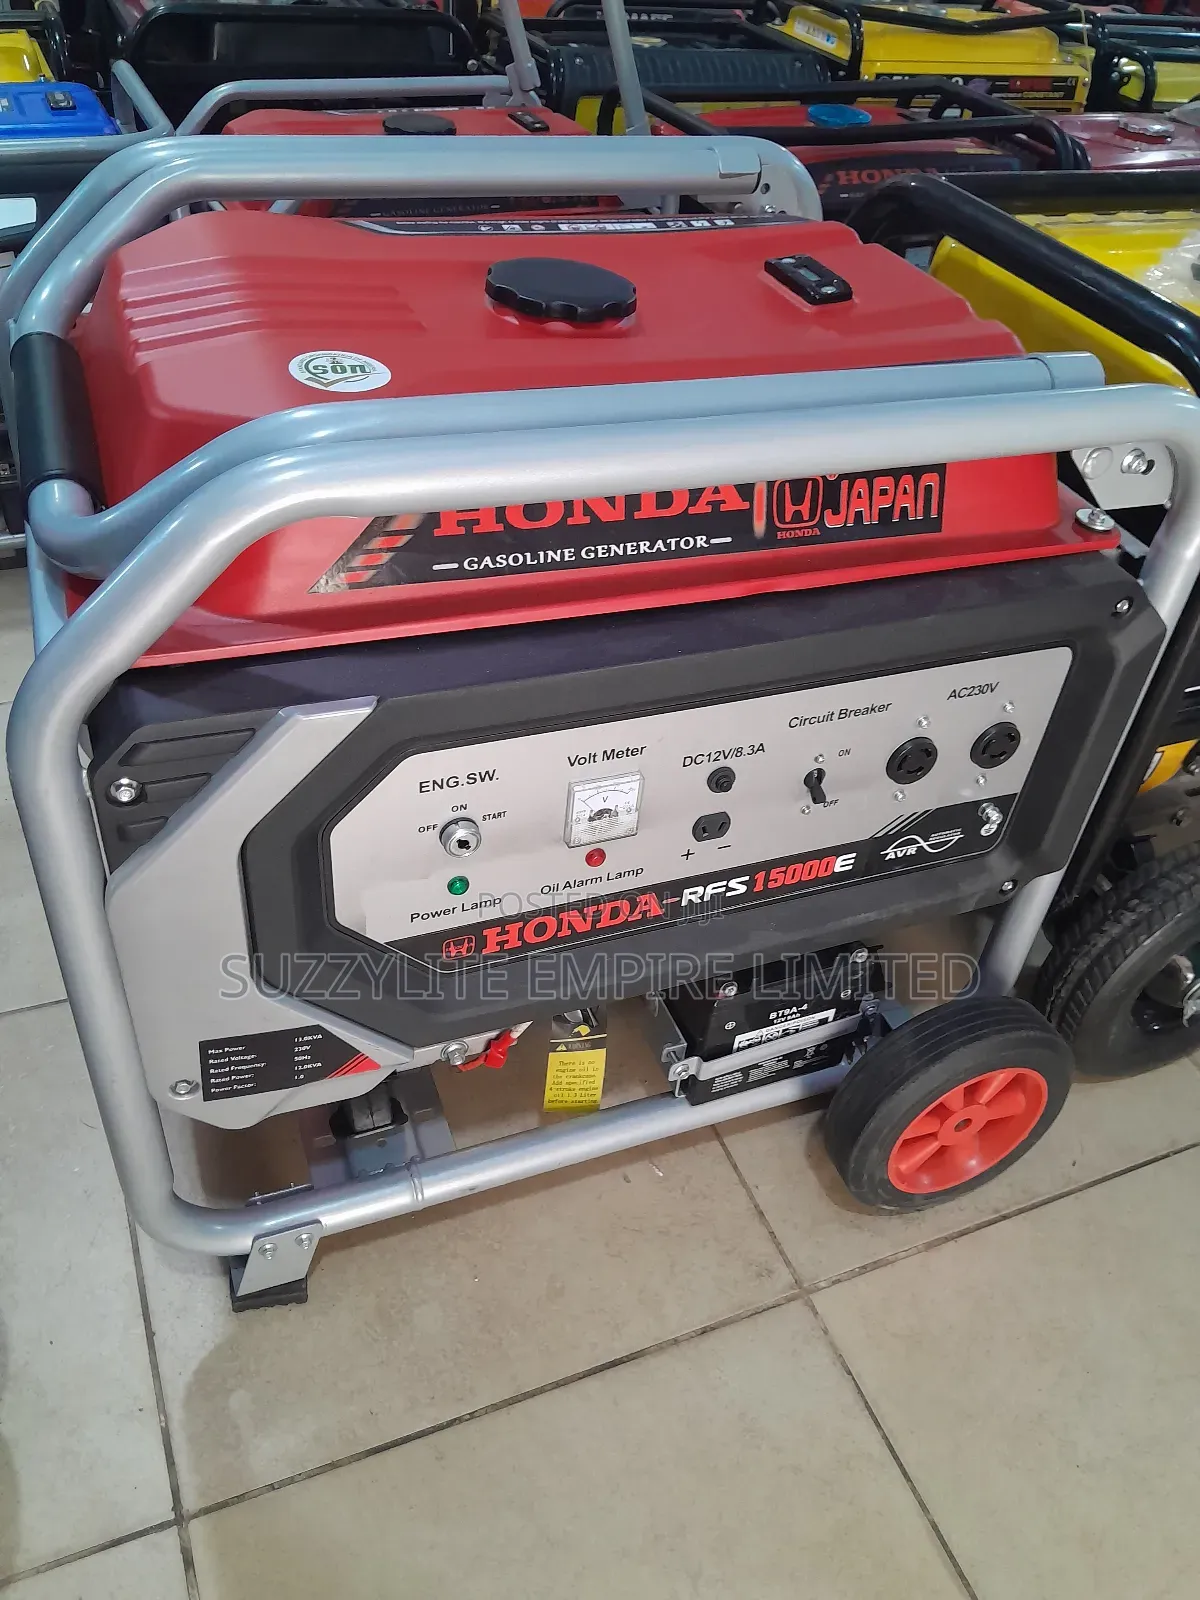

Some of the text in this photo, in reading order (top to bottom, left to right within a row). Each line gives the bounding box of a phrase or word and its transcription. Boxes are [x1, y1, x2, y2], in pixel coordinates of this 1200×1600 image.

[777, 527, 821, 540] HONDA
[463, 535, 710, 571] GASOLINE GENERATOR
[946, 681, 999, 701] AC230V
[788, 701, 892, 730] Circuit Breaker
[567, 744, 647, 768] Volt Meter
[681, 742, 766, 769] DC12V/8.3A
[838, 748, 851, 758] ON
[418, 768, 500, 794] ENG.SW.
[451, 803, 468, 813] ON
[823, 798, 840, 809] OFF
[482, 810, 508, 823] START
[418, 823, 439, 834] OFF
[884, 847, 918, 861] AVR
[540, 866, 645, 896] Oil Alarm Lamp
[409, 897, 502, 923] Power Lamp
[481, 892, 665, 955] HONDA
[769, 1003, 808, 1020] BT9A-4
[209, 1066, 230, 1074] Rated
